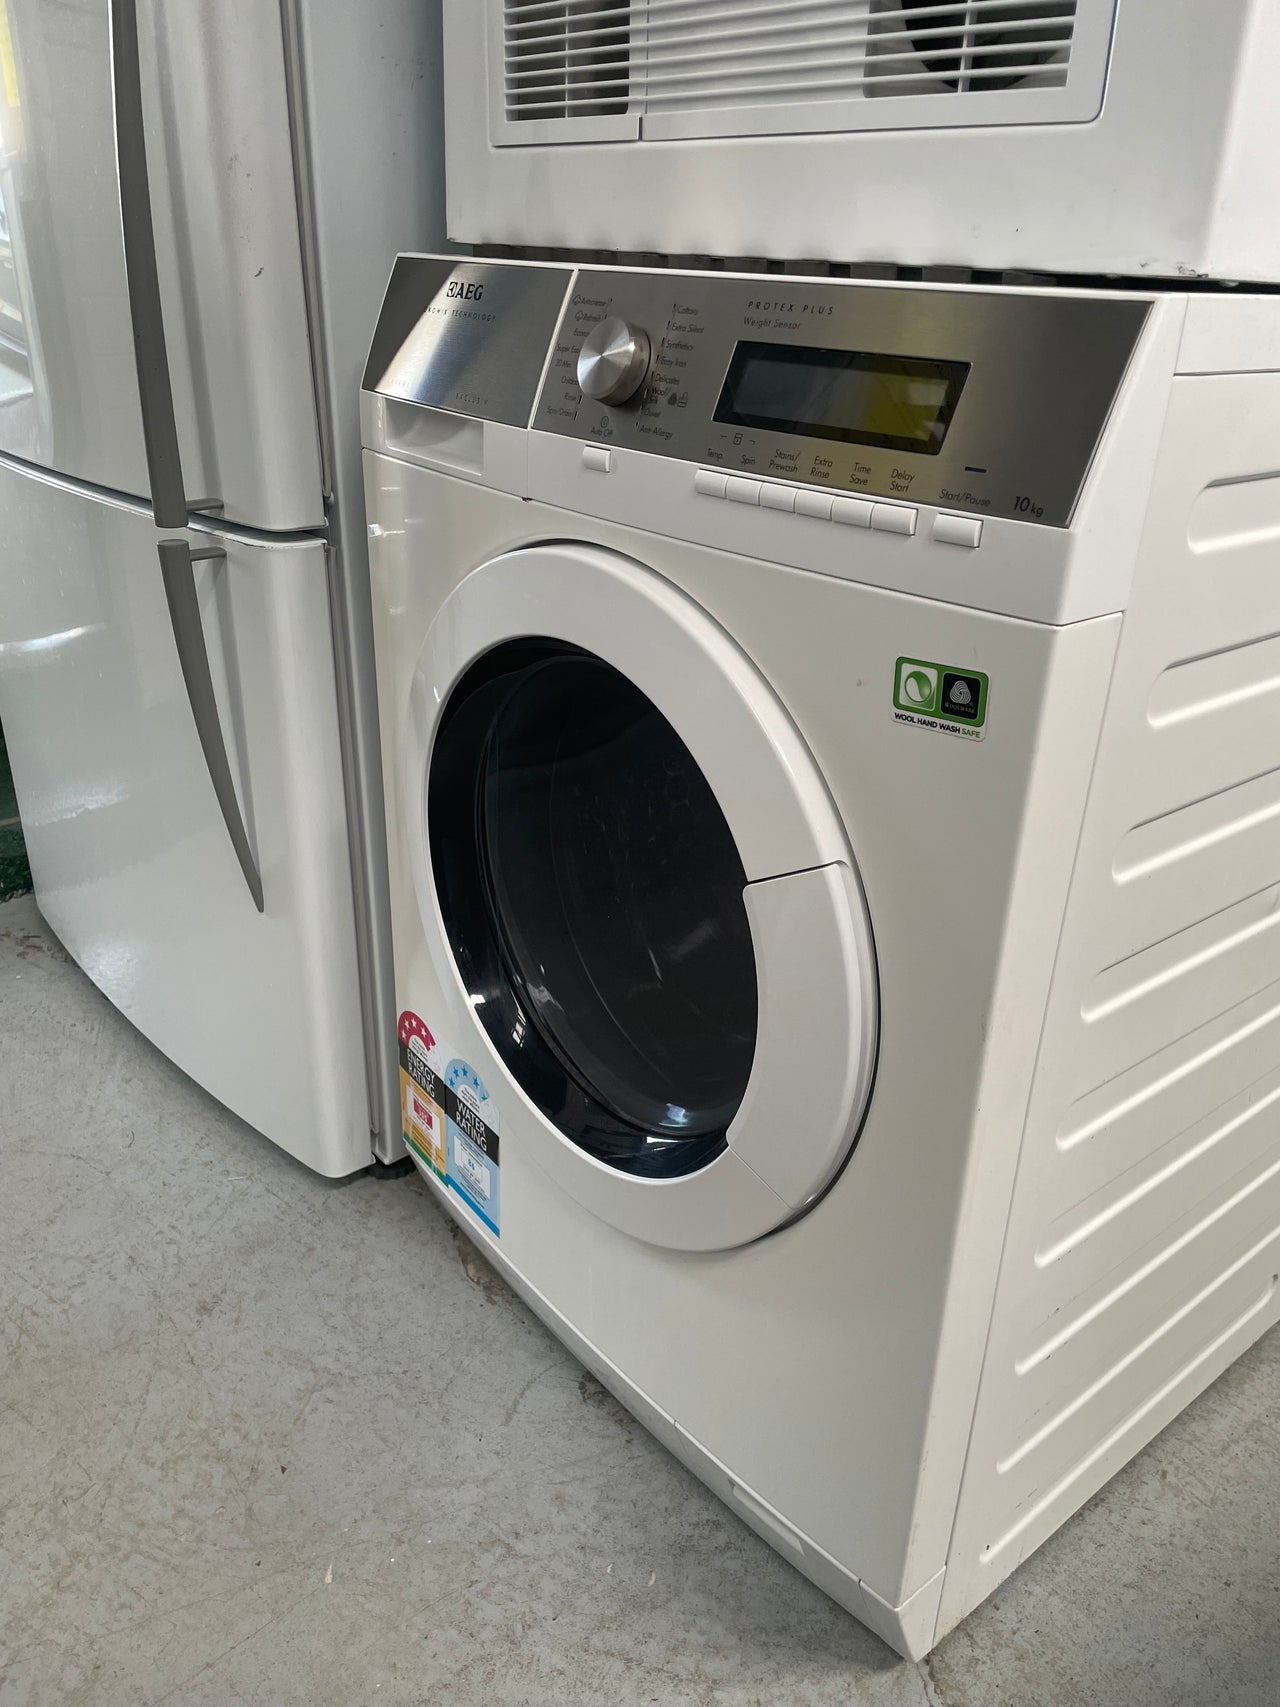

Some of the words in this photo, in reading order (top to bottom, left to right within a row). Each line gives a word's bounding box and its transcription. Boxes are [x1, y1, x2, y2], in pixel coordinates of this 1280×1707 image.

[455, 283, 484, 301] AEG
[748, 300, 795, 313] PROTEX
[803, 304, 835, 316] PLUS
[452, 309, 497, 324] TECHNOLOGY
[743, 316, 772, 329] Weight
[774, 318, 802, 330] Sensor
[740, 454, 756, 466] Spin
[768, 459, 798, 474] Prewash
[814, 455, 833, 468] Extra
[810, 467, 830, 480] Rinse
[853, 461, 872, 475] Time
[891, 468, 917, 483] Delay
[849, 474, 869, 487] Save
[890, 480, 910, 494] Start
[938, 488, 992, 508] Start/Pause
[1012, 495, 1030, 513] 10
[1030, 501, 1045, 519] kg
[894, 712, 917, 724] WOOL
[917, 717, 938, 729] HAND
[938, 722, 961, 735] WASH
[961, 727, 981, 739] SAFE
[406, 1048, 436, 1086] ENERGY
[407, 1060, 436, 1099] RATING
[455, 1098, 486, 1137] WATER
[455, 1108, 488, 1152] RATING
